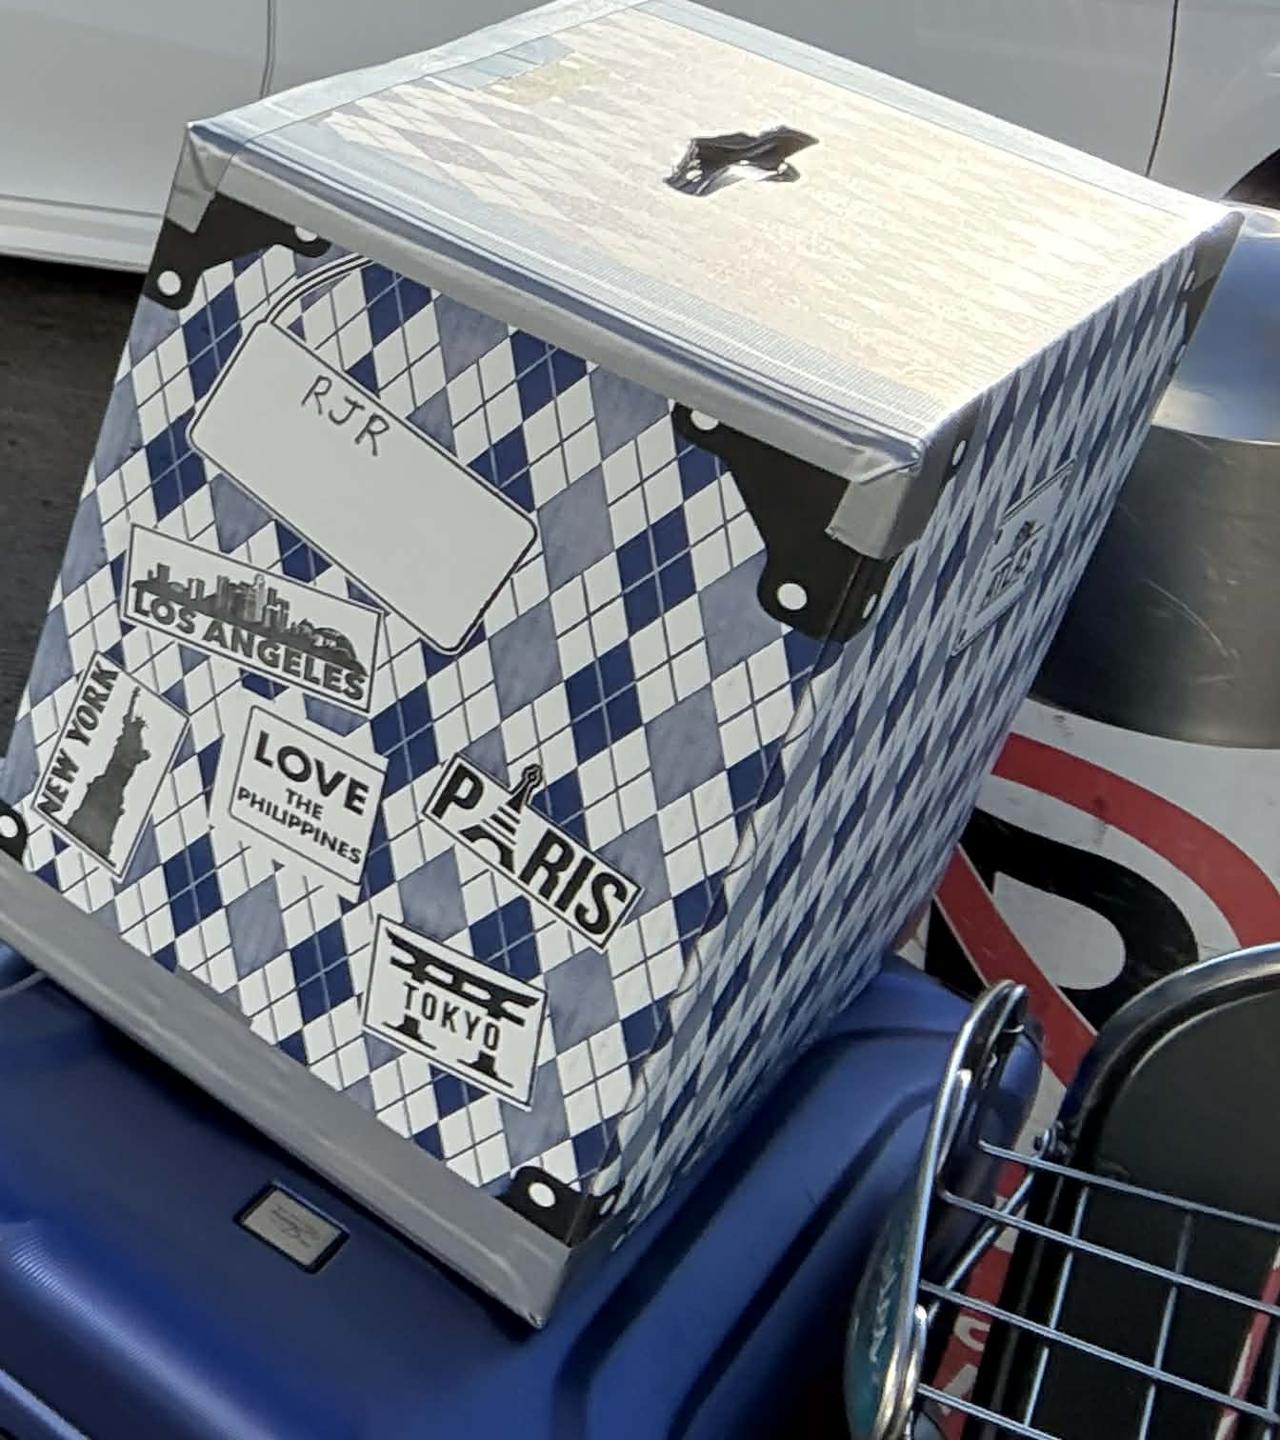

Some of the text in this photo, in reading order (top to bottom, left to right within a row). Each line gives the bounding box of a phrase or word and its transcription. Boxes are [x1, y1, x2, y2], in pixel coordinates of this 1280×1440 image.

[300, 374, 391, 457] RJR
[133, 584, 367, 702] LOS ANGELES
[36, 660, 120, 815] NEW YORK
[253, 729, 370, 817] LOVE
[236, 788, 363, 867] PHILIPPINES
[284, 789, 325, 822] THE
[430, 762, 627, 937] PARIS
[401, 981, 501, 1051] TOKYO
